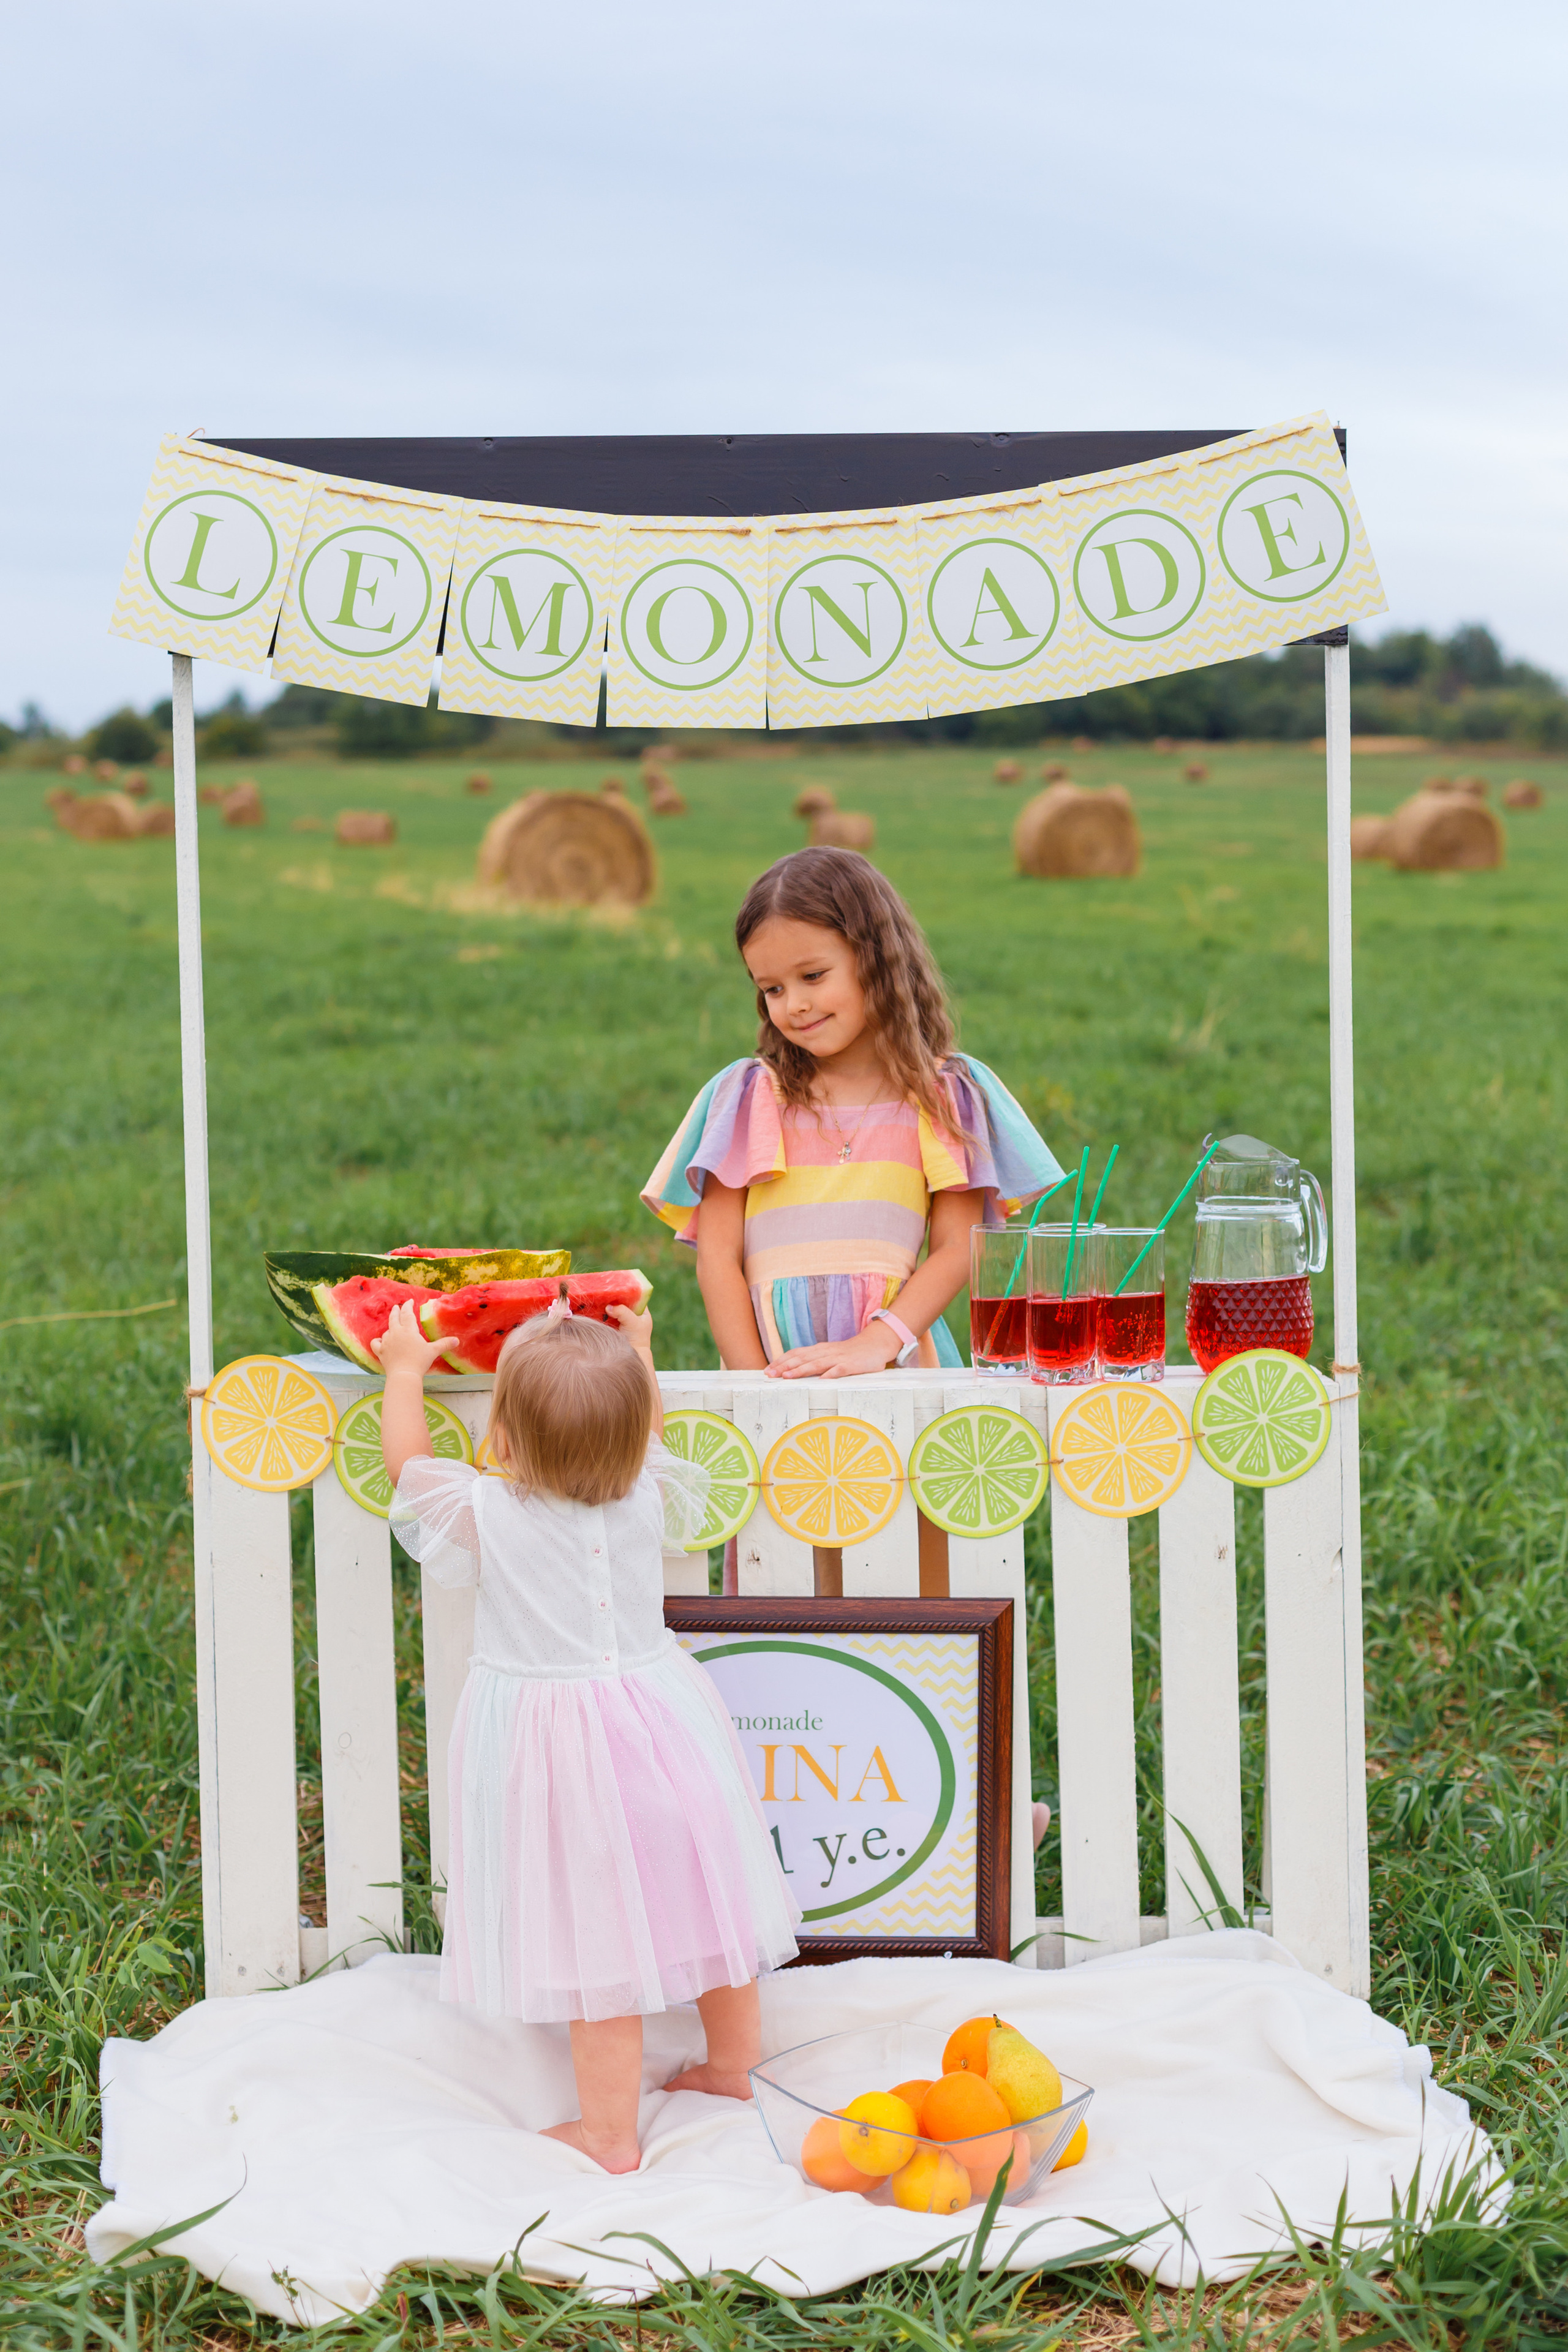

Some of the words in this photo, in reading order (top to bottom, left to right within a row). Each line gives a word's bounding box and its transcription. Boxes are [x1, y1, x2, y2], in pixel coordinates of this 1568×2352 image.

[170, 492, 1327, 665] LEMONADE
[731, 1709, 823, 1730] monade
[756, 1744, 908, 1802] INA
